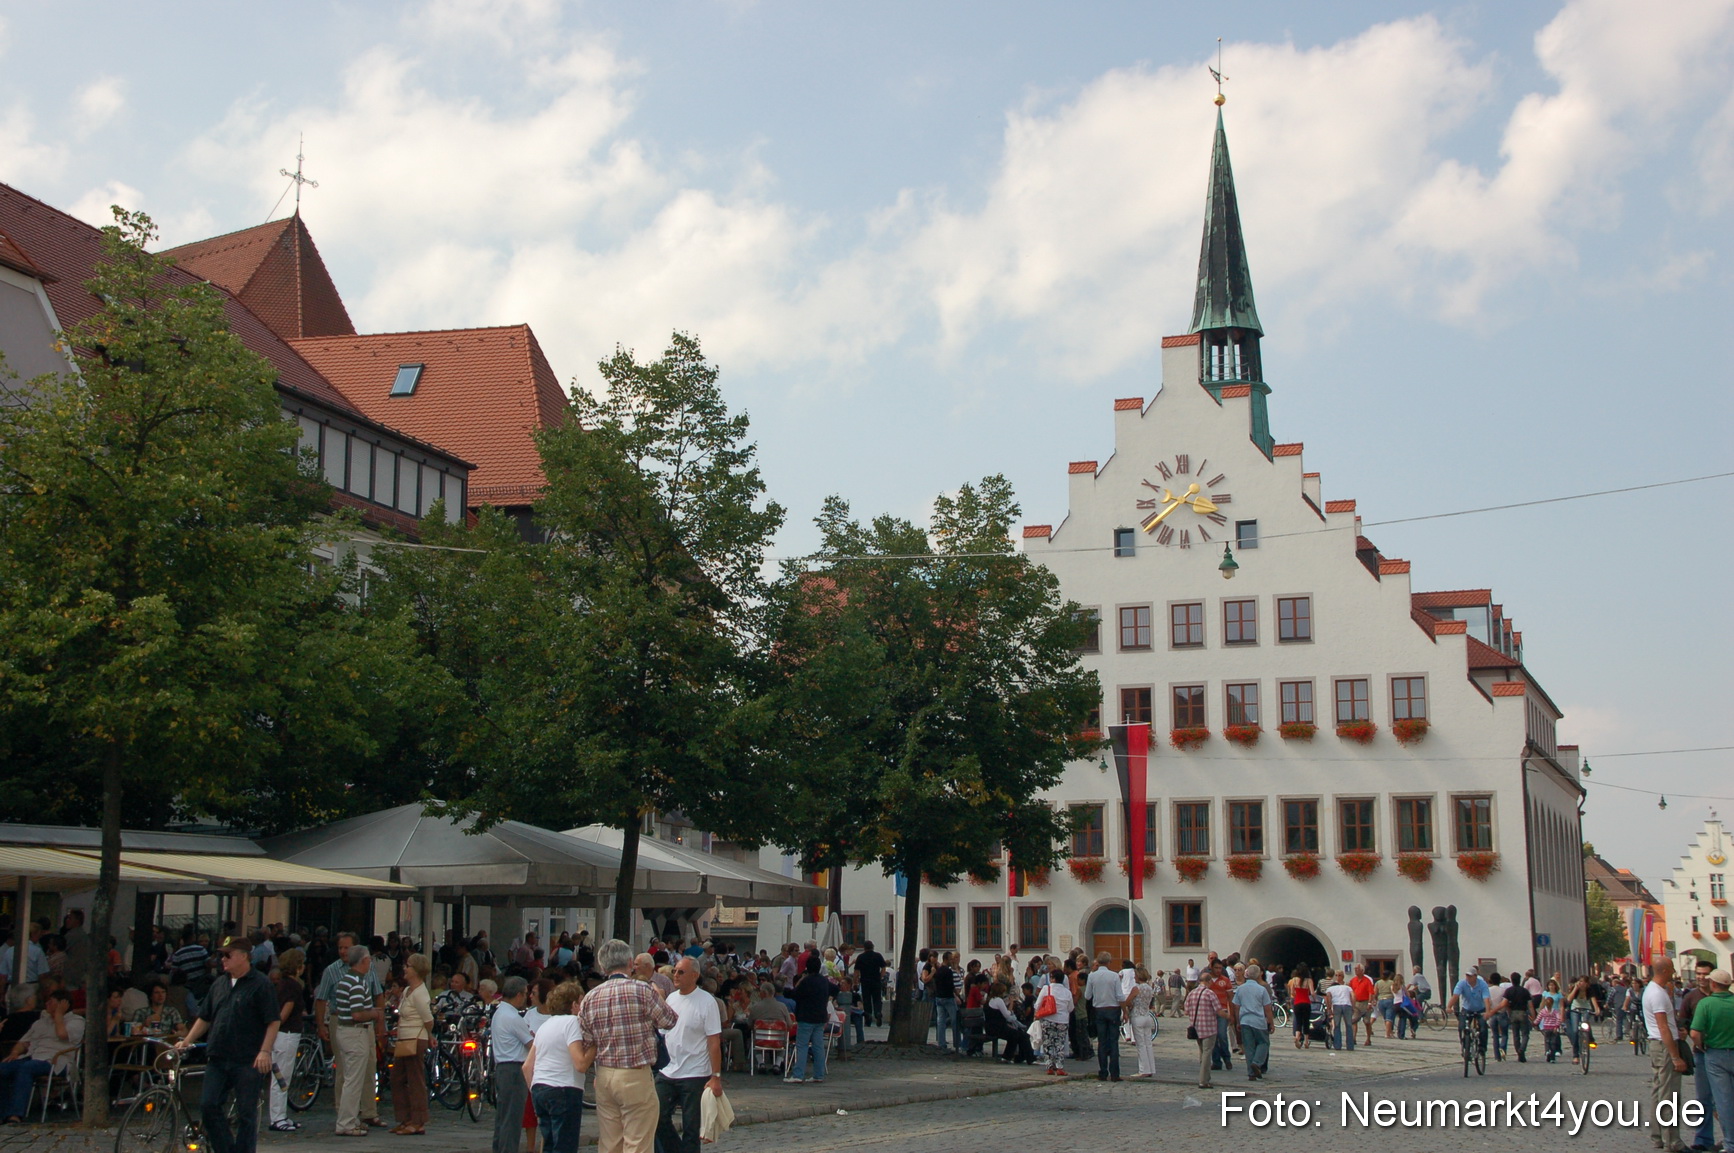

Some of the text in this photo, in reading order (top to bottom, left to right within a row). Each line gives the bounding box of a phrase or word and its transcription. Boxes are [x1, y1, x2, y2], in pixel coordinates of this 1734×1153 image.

[1155, 461, 1173, 481] XI
[1175, 454, 1189, 474] XII
[1141, 479, 1160, 493] X
[1206, 473, 1225, 488] II
[1136, 498, 1156, 509] IX
[1211, 494, 1231, 504] III
[1197, 524, 1211, 542] V
